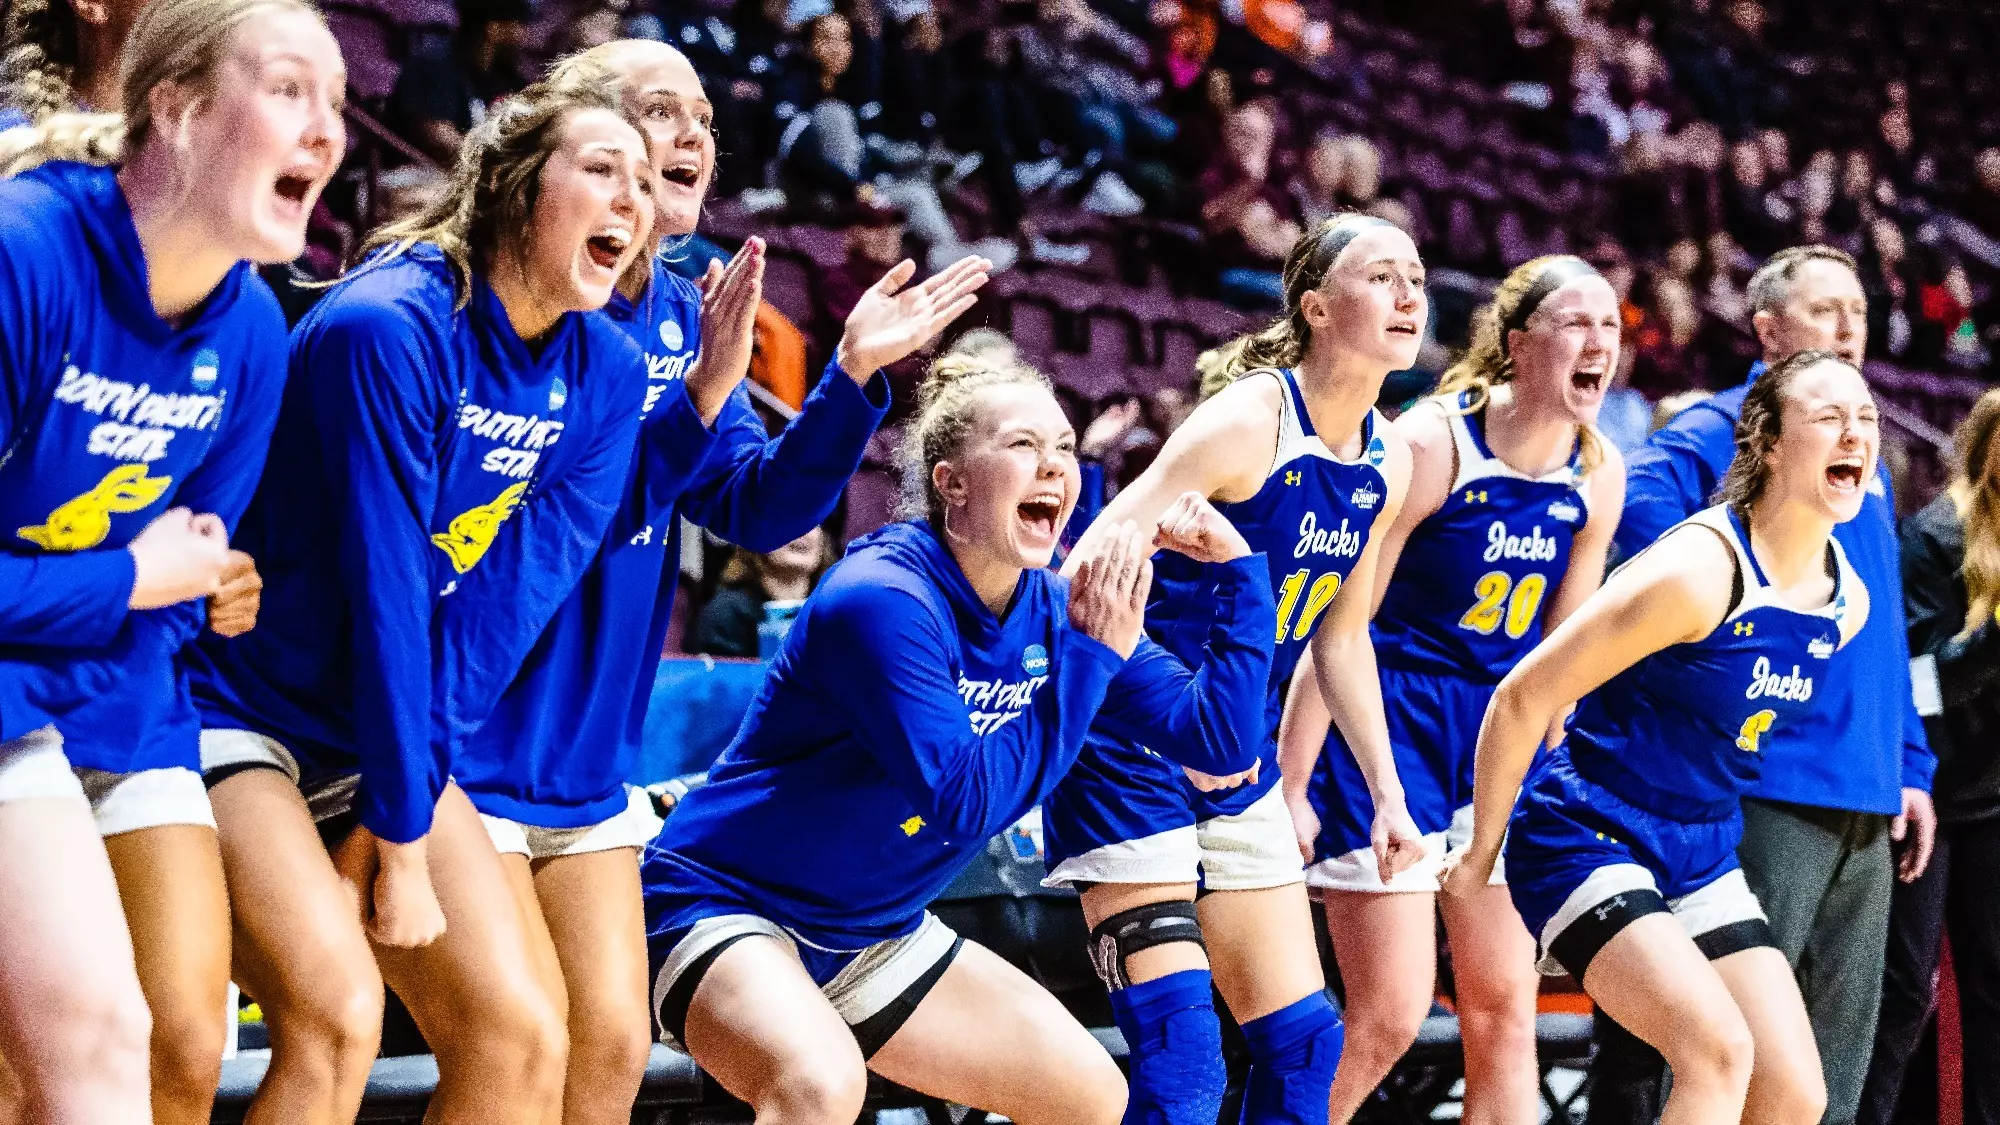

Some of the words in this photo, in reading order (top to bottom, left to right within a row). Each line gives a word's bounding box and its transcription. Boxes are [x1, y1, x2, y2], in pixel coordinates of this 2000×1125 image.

[1293, 511, 1360, 559] Jacks
[1483, 520, 1557, 562] Jacks
[1275, 568, 1342, 644] 10
[1458, 570, 1547, 640] 20
[1745, 656, 1813, 702] Jacks
